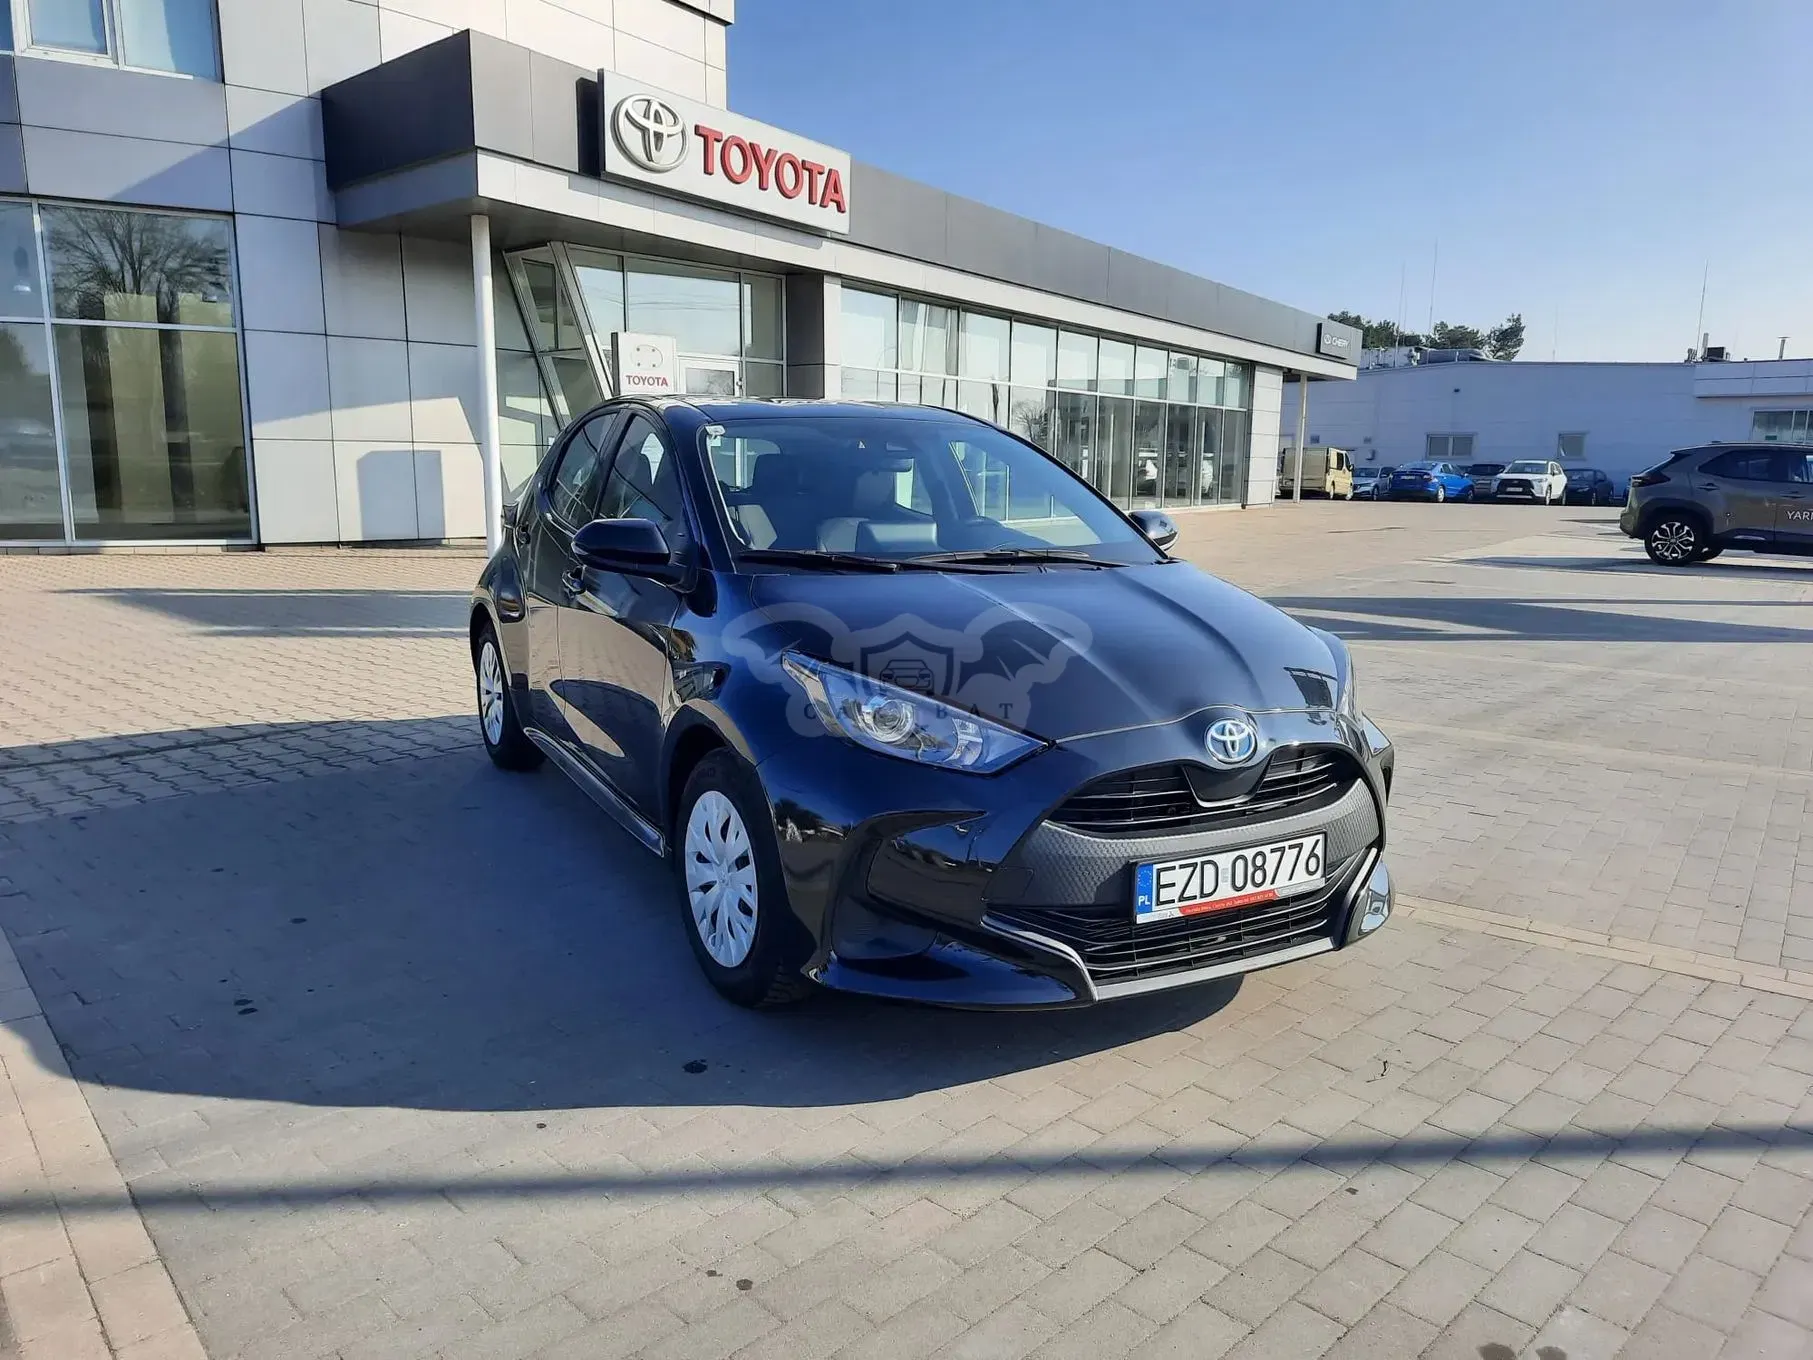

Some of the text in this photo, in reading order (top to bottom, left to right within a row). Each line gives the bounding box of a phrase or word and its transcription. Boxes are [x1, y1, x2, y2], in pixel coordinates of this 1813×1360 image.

[694, 124, 846, 213] TOYOTA
[625, 375, 669, 387] TOYOTA
[1155, 859, 1219, 906] EZD
[1231, 839, 1321, 892] 08776
[1138, 895, 1150, 906] PL
